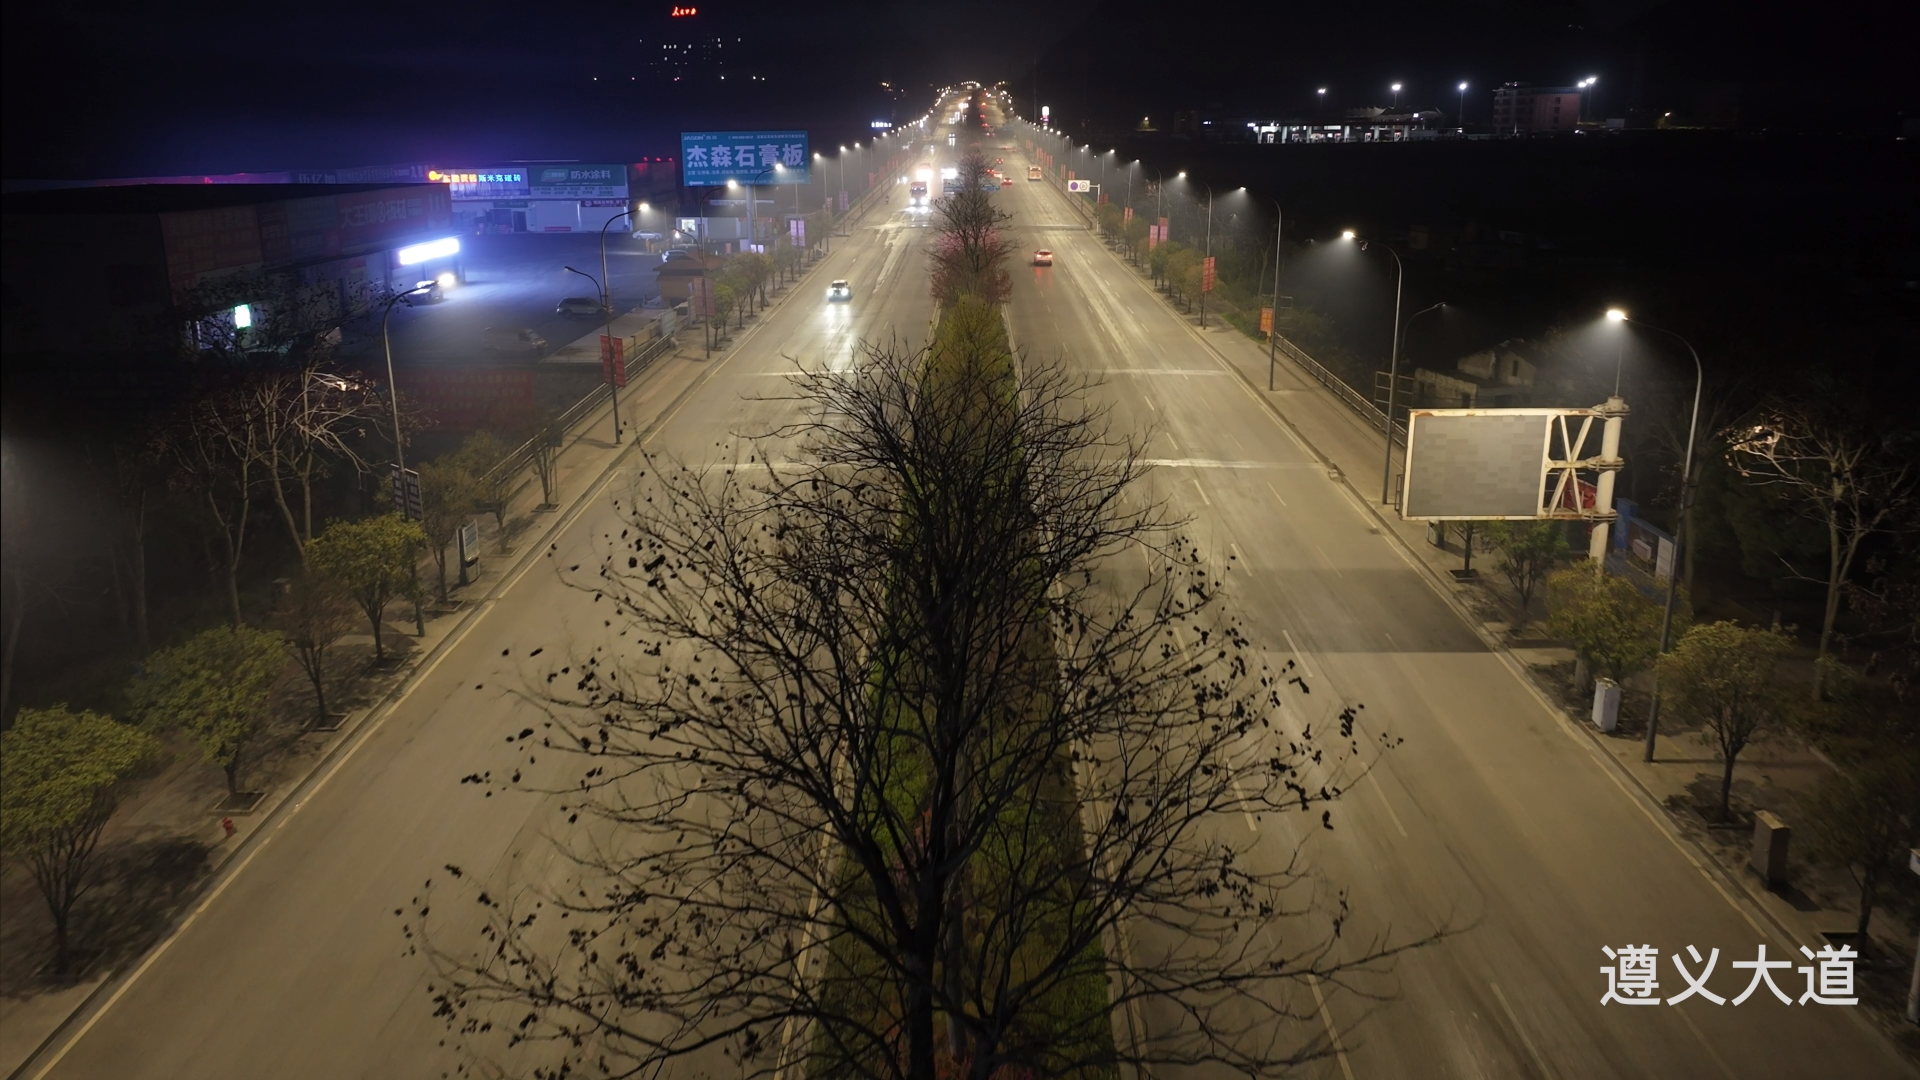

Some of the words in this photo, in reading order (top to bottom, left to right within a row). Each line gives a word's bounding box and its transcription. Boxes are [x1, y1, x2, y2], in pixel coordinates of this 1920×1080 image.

[687, 143, 804, 168] 杰森石膏板
[570, 170, 611, 180] 防水涂料
